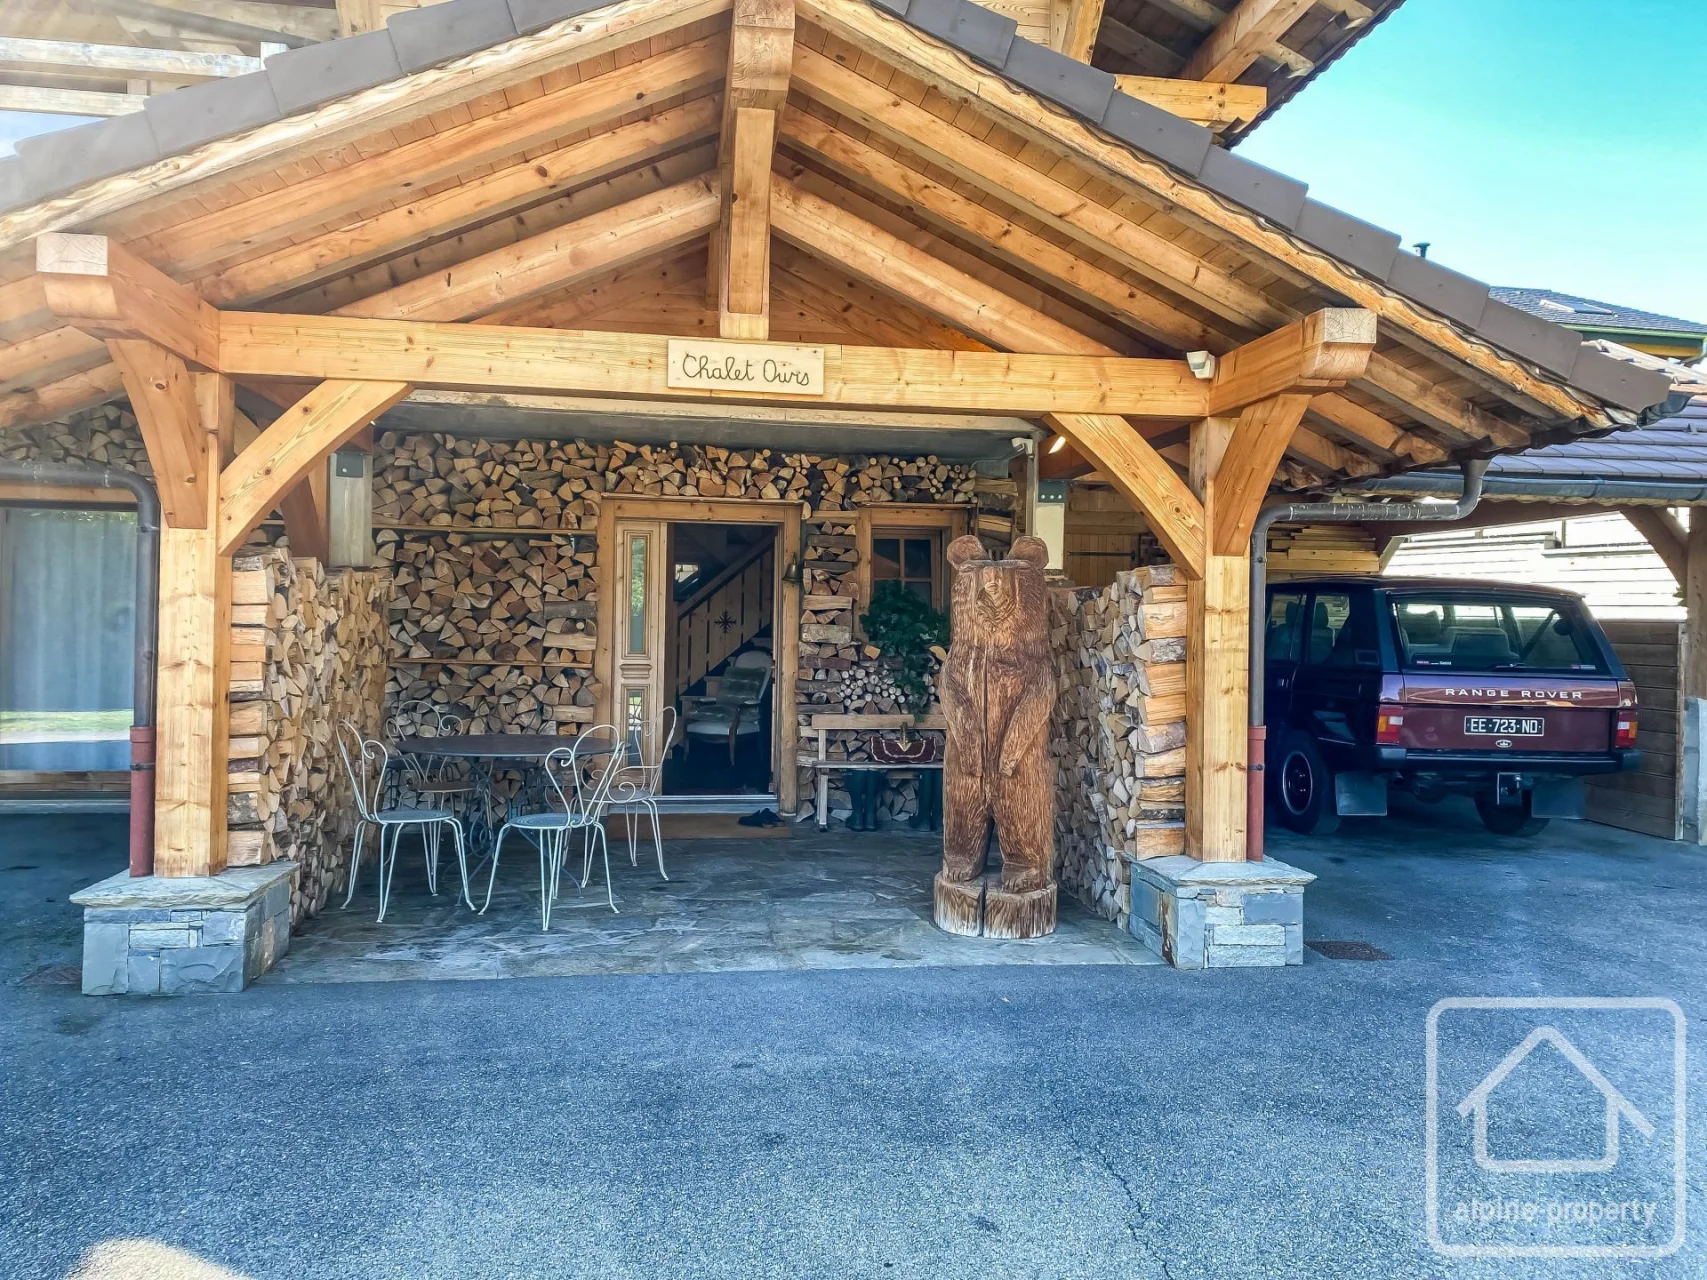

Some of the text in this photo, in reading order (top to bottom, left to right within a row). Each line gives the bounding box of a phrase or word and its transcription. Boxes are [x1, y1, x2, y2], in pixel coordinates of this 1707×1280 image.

[682, 354, 810, 386] Chalet Ours
[1445, 688, 1582, 699] RANGE ROVER
